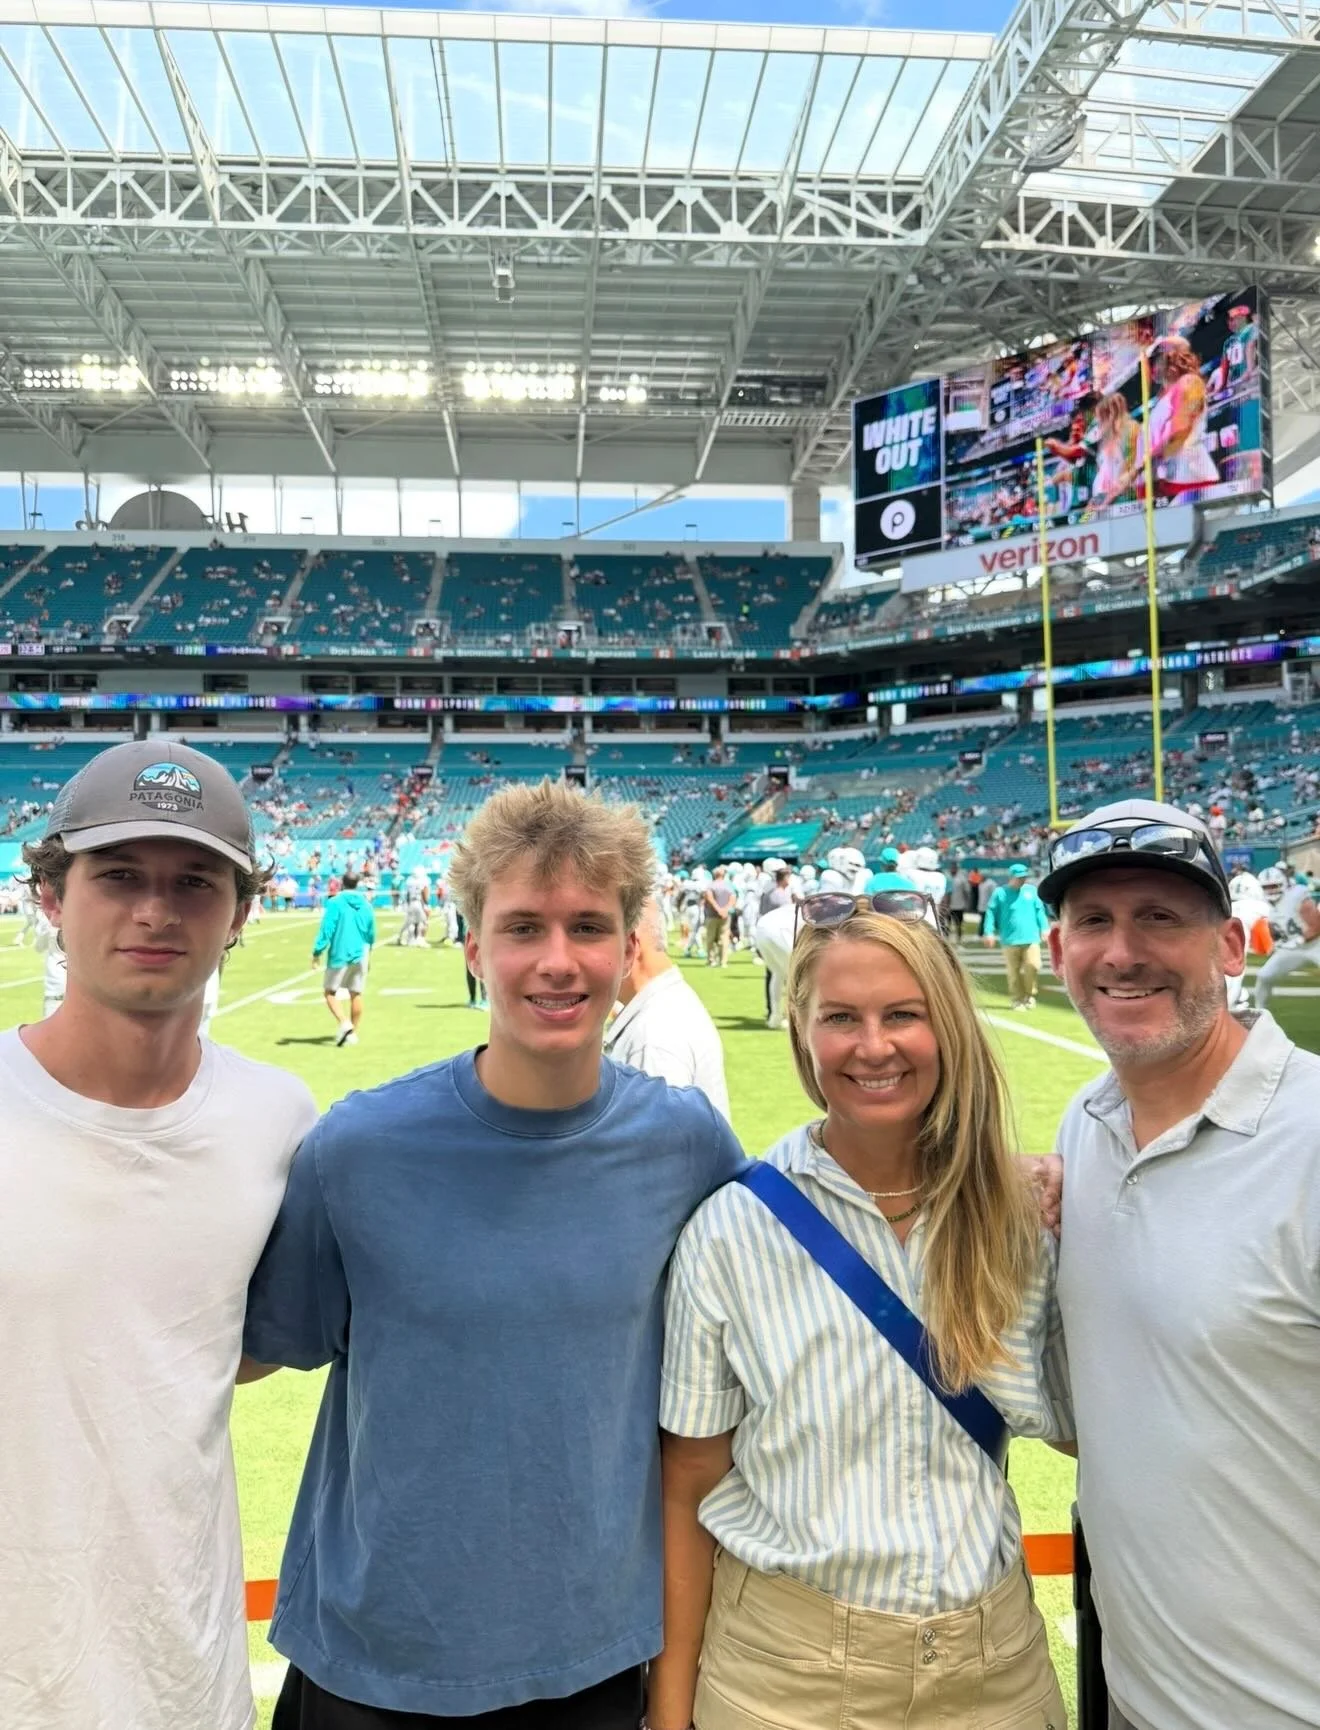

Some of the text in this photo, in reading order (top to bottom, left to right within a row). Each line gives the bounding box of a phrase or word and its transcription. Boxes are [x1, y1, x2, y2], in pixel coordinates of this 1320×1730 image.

[862, 406, 937, 451] WHITE
[875, 438, 923, 475] OUT
[980, 533, 1099, 572] verizon
[129, 791, 204, 811] PATAGONIA
[157, 802, 178, 811] 1973
